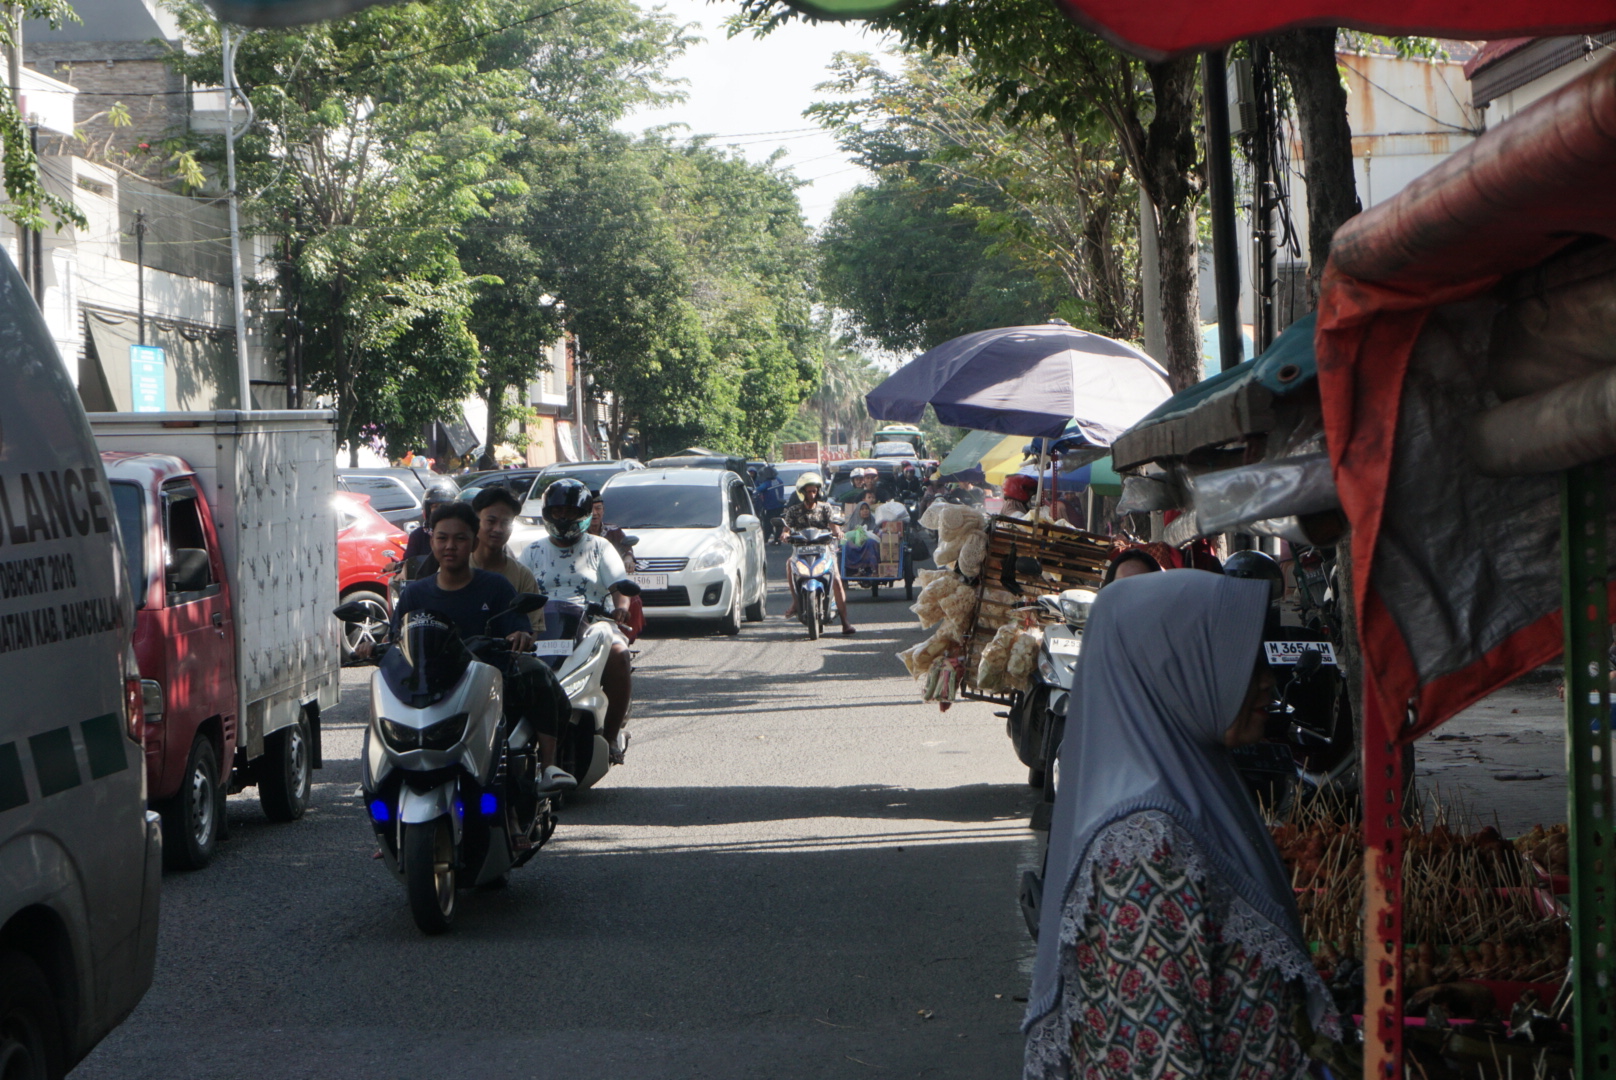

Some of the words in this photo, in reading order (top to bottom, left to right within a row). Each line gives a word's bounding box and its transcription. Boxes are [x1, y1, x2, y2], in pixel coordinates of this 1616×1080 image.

[0, 467, 109, 547] LANCE
[48, 553, 76, 590] 2018
[0, 611, 33, 653] ATAN
[32, 606, 62, 646] KAB.
[1270, 643, 1279, 654] M
